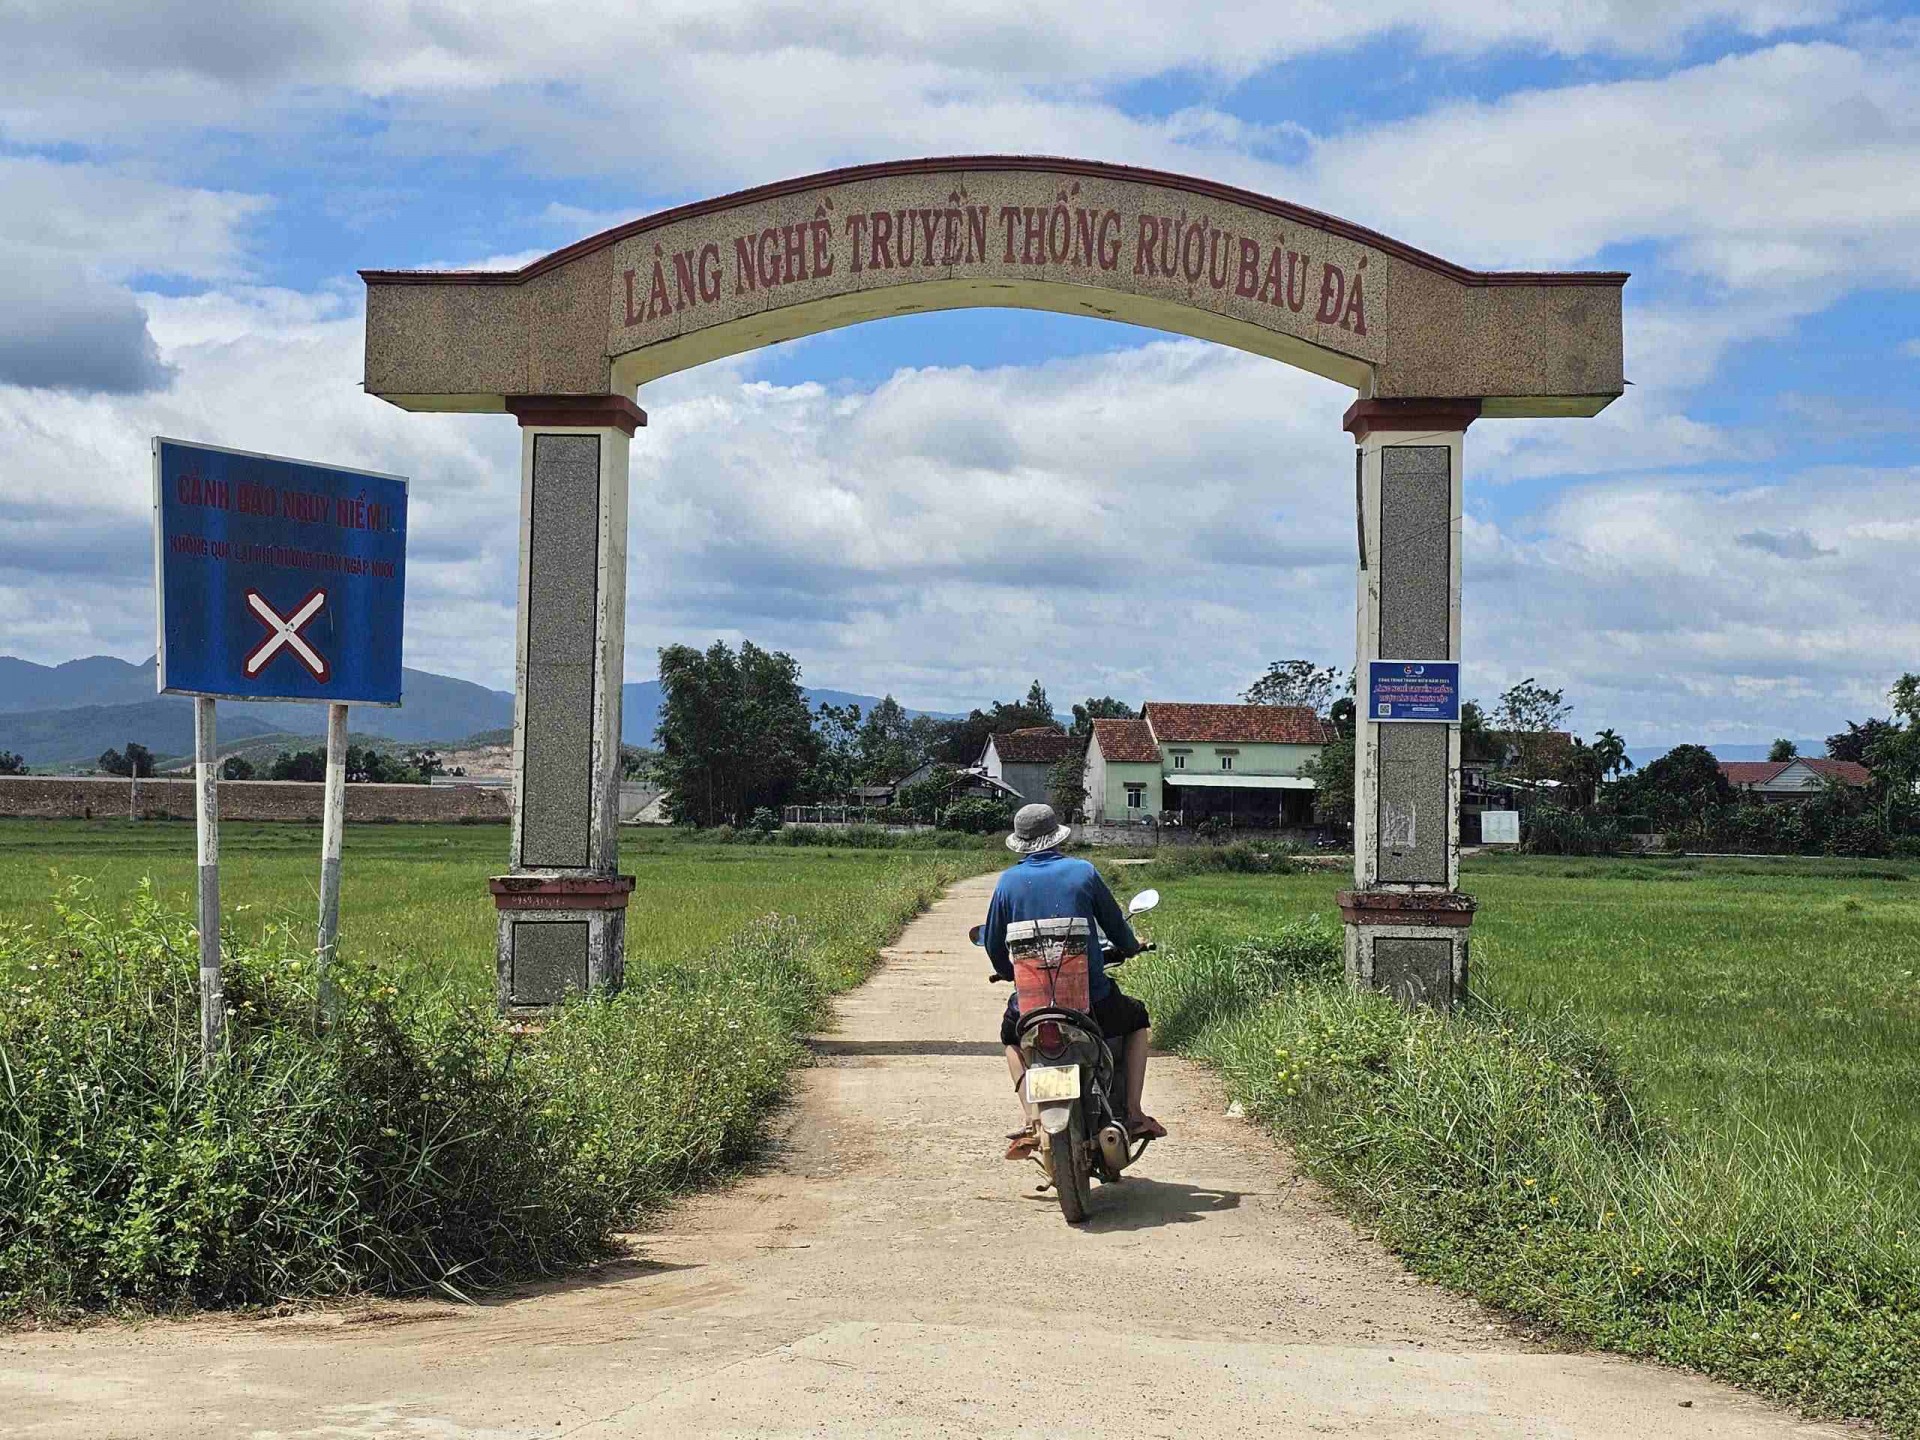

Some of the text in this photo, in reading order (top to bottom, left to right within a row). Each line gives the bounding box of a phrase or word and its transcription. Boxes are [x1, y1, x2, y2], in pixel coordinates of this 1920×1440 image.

[624, 182, 1367, 336] LÀNG NGHỀ TRUYỀN THỐNG RƯỢU BÀU ĐÁ
[176, 466, 230, 511] CẢNH
[281, 489, 330, 524] NGUY
